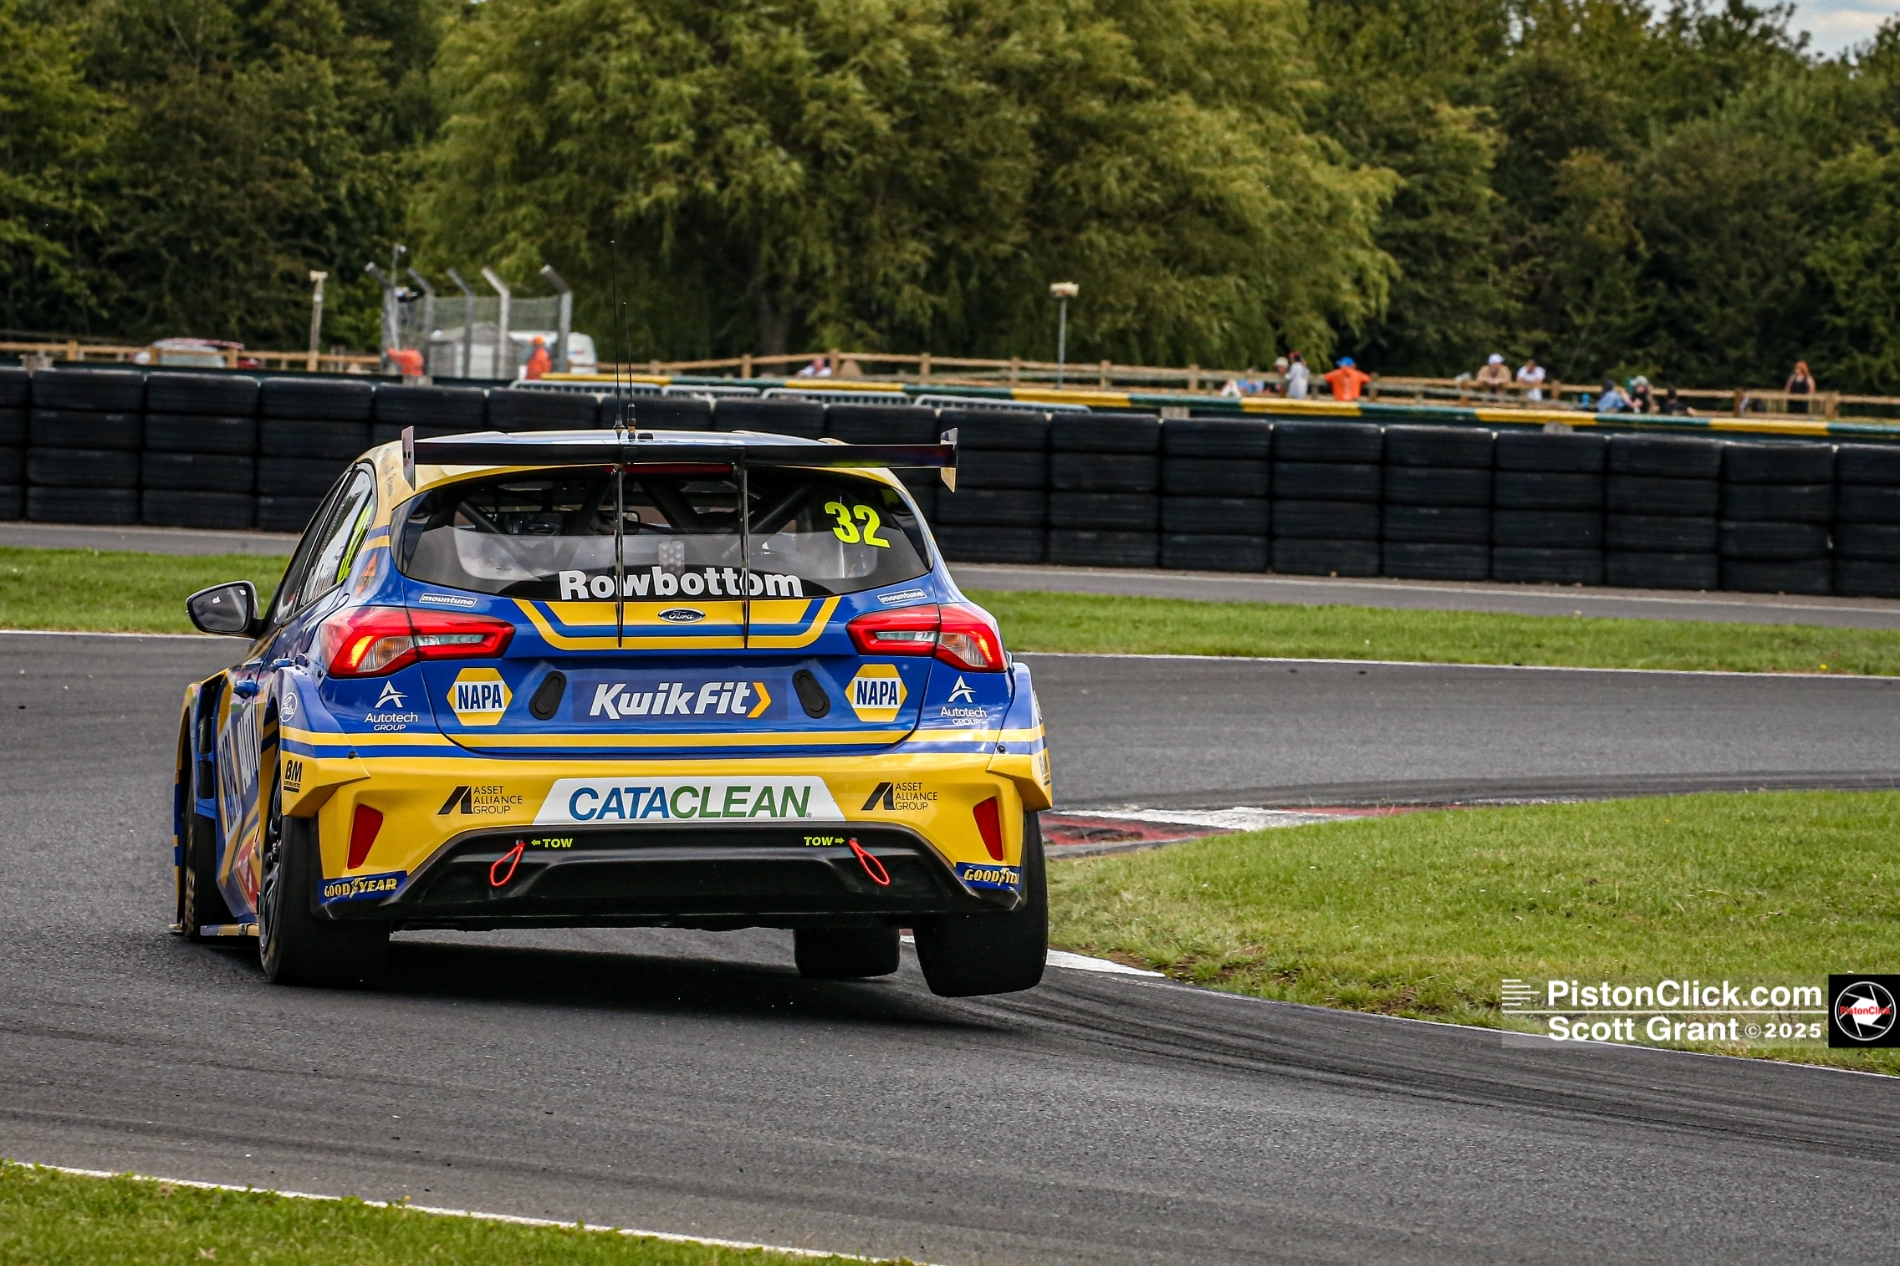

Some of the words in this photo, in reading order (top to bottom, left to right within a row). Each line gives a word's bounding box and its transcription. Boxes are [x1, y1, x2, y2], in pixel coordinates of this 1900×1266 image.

[825, 502, 890, 548] 32
[559, 566, 803, 600] Rowbottom
[421, 594, 474, 606] mountune
[880, 592, 924, 603] mountune
[458, 684, 503, 709] NAPA
[856, 680, 898, 705] NAPA
[364, 712, 419, 723] Autotech
[940, 706, 987, 718] Autotech
[285, 760, 303, 782] BM
[473, 786, 504, 794] ASSET
[895, 782, 922, 791] ASSET
[473, 795, 523, 804] ALLIANCE
[895, 792, 938, 801] ALLIANCE
[473, 805, 511, 814] GROUP
[895, 801, 928, 810] GROUP
[542, 838, 573, 848] TOW
[803, 836, 833, 846] TOW
[324, 877, 398, 898] GOODYEAR
